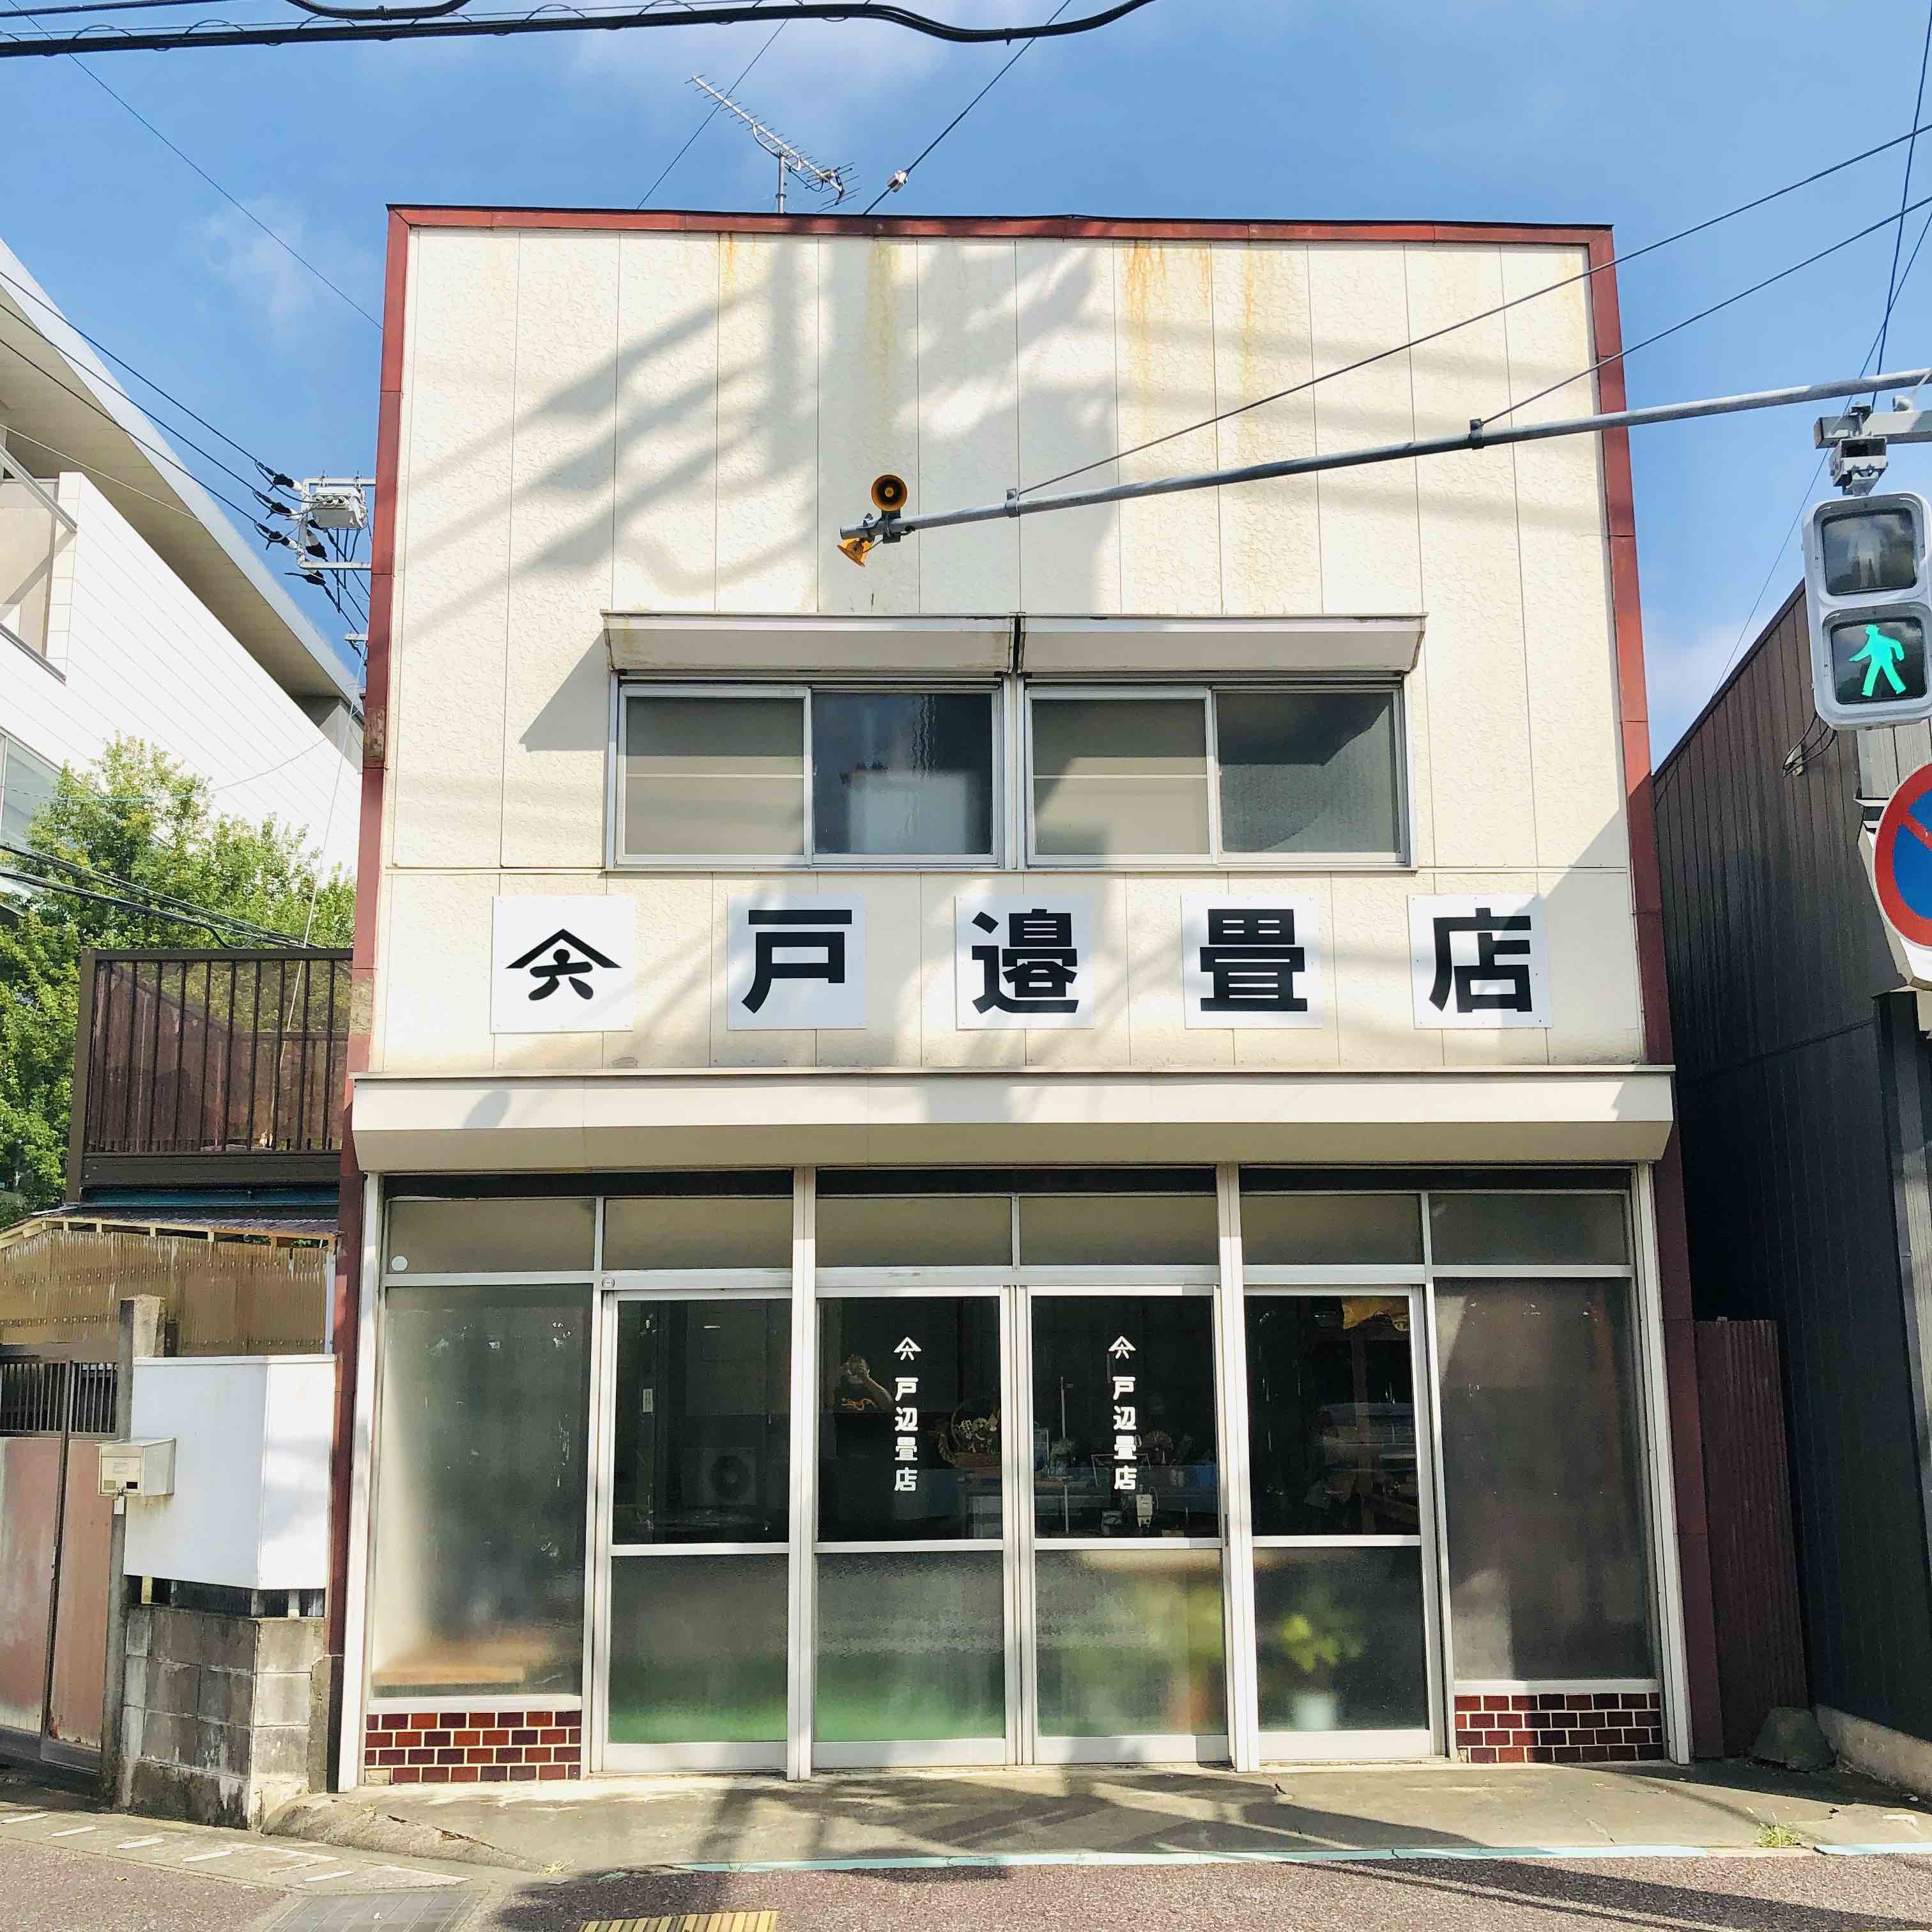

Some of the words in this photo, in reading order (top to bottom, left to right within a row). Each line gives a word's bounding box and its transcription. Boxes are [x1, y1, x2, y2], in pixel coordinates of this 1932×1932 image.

[894, 1376, 919, 1492] 戸辺畳店
[1112, 1376, 1137, 1490] 戸辺畳店
